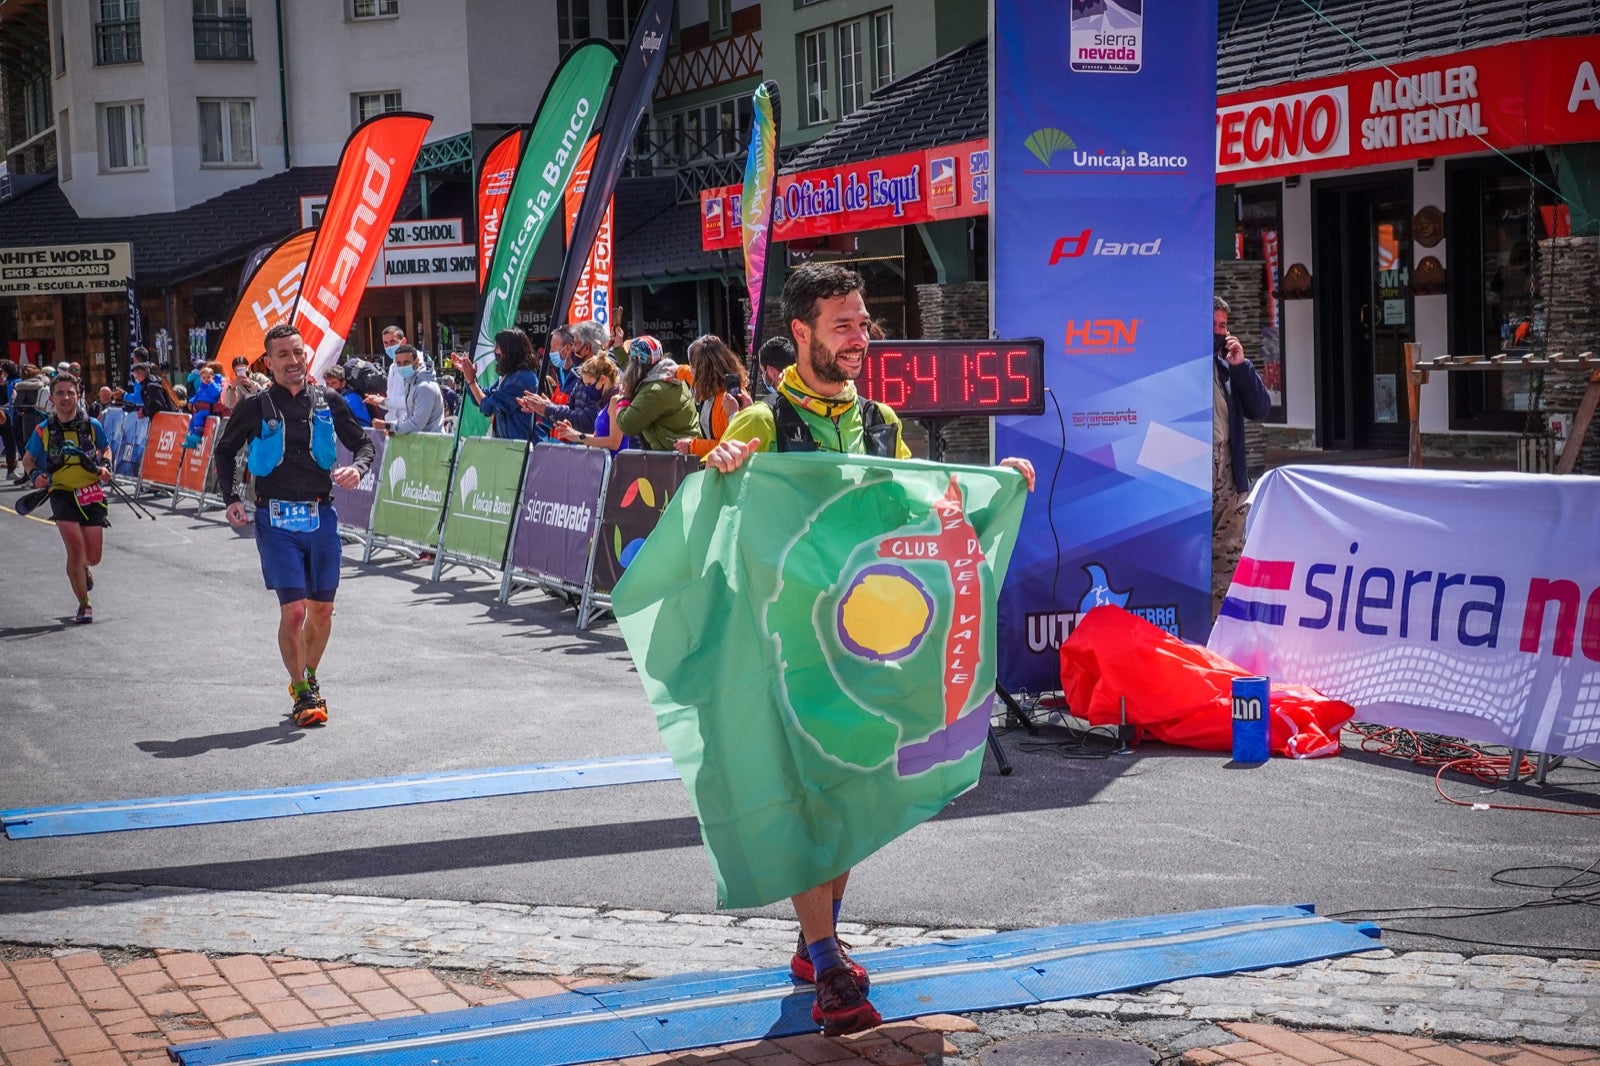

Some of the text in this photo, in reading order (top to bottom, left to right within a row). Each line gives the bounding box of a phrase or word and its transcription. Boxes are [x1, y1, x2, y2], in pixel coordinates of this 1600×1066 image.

[1094, 31, 1136, 46] sierra
[1079, 46, 1136, 60] nevada
[1369, 65, 1478, 114] ALQUILER
[1216, 93, 1341, 166] ECNO
[1361, 102, 1488, 150] SKI RENTAL
[1073, 149, 1187, 171] Unicaja Banco
[497, 189, 551, 300] Unicaja
[542, 97, 590, 187] Banco
[785, 173, 843, 219] Oficial
[845, 172, 866, 210] de
[868, 164, 920, 217] Esquí
[50, 249, 116, 263] WORLD
[386, 258, 430, 275] ALQUILER
[432, 258, 447, 273] SKI
[36, 265, 107, 277] SNOWBOARD
[0, 283, 30, 292] UILER
[251, 262, 307, 331] HS
[1065, 319, 1138, 346] HSN
[867, 350, 1030, 406] 16:41:55
[402, 480, 442, 504] Unicaja Banco
[472, 492, 511, 517] Unicaja Banco
[285, 506, 306, 517] 154
[892, 541, 939, 557] CLUB
[1299, 541, 1506, 649] sierra
[1028, 613, 1087, 652] ULT
[951, 613, 977, 684] VALLE
[1231, 698, 1261, 720] ULT
